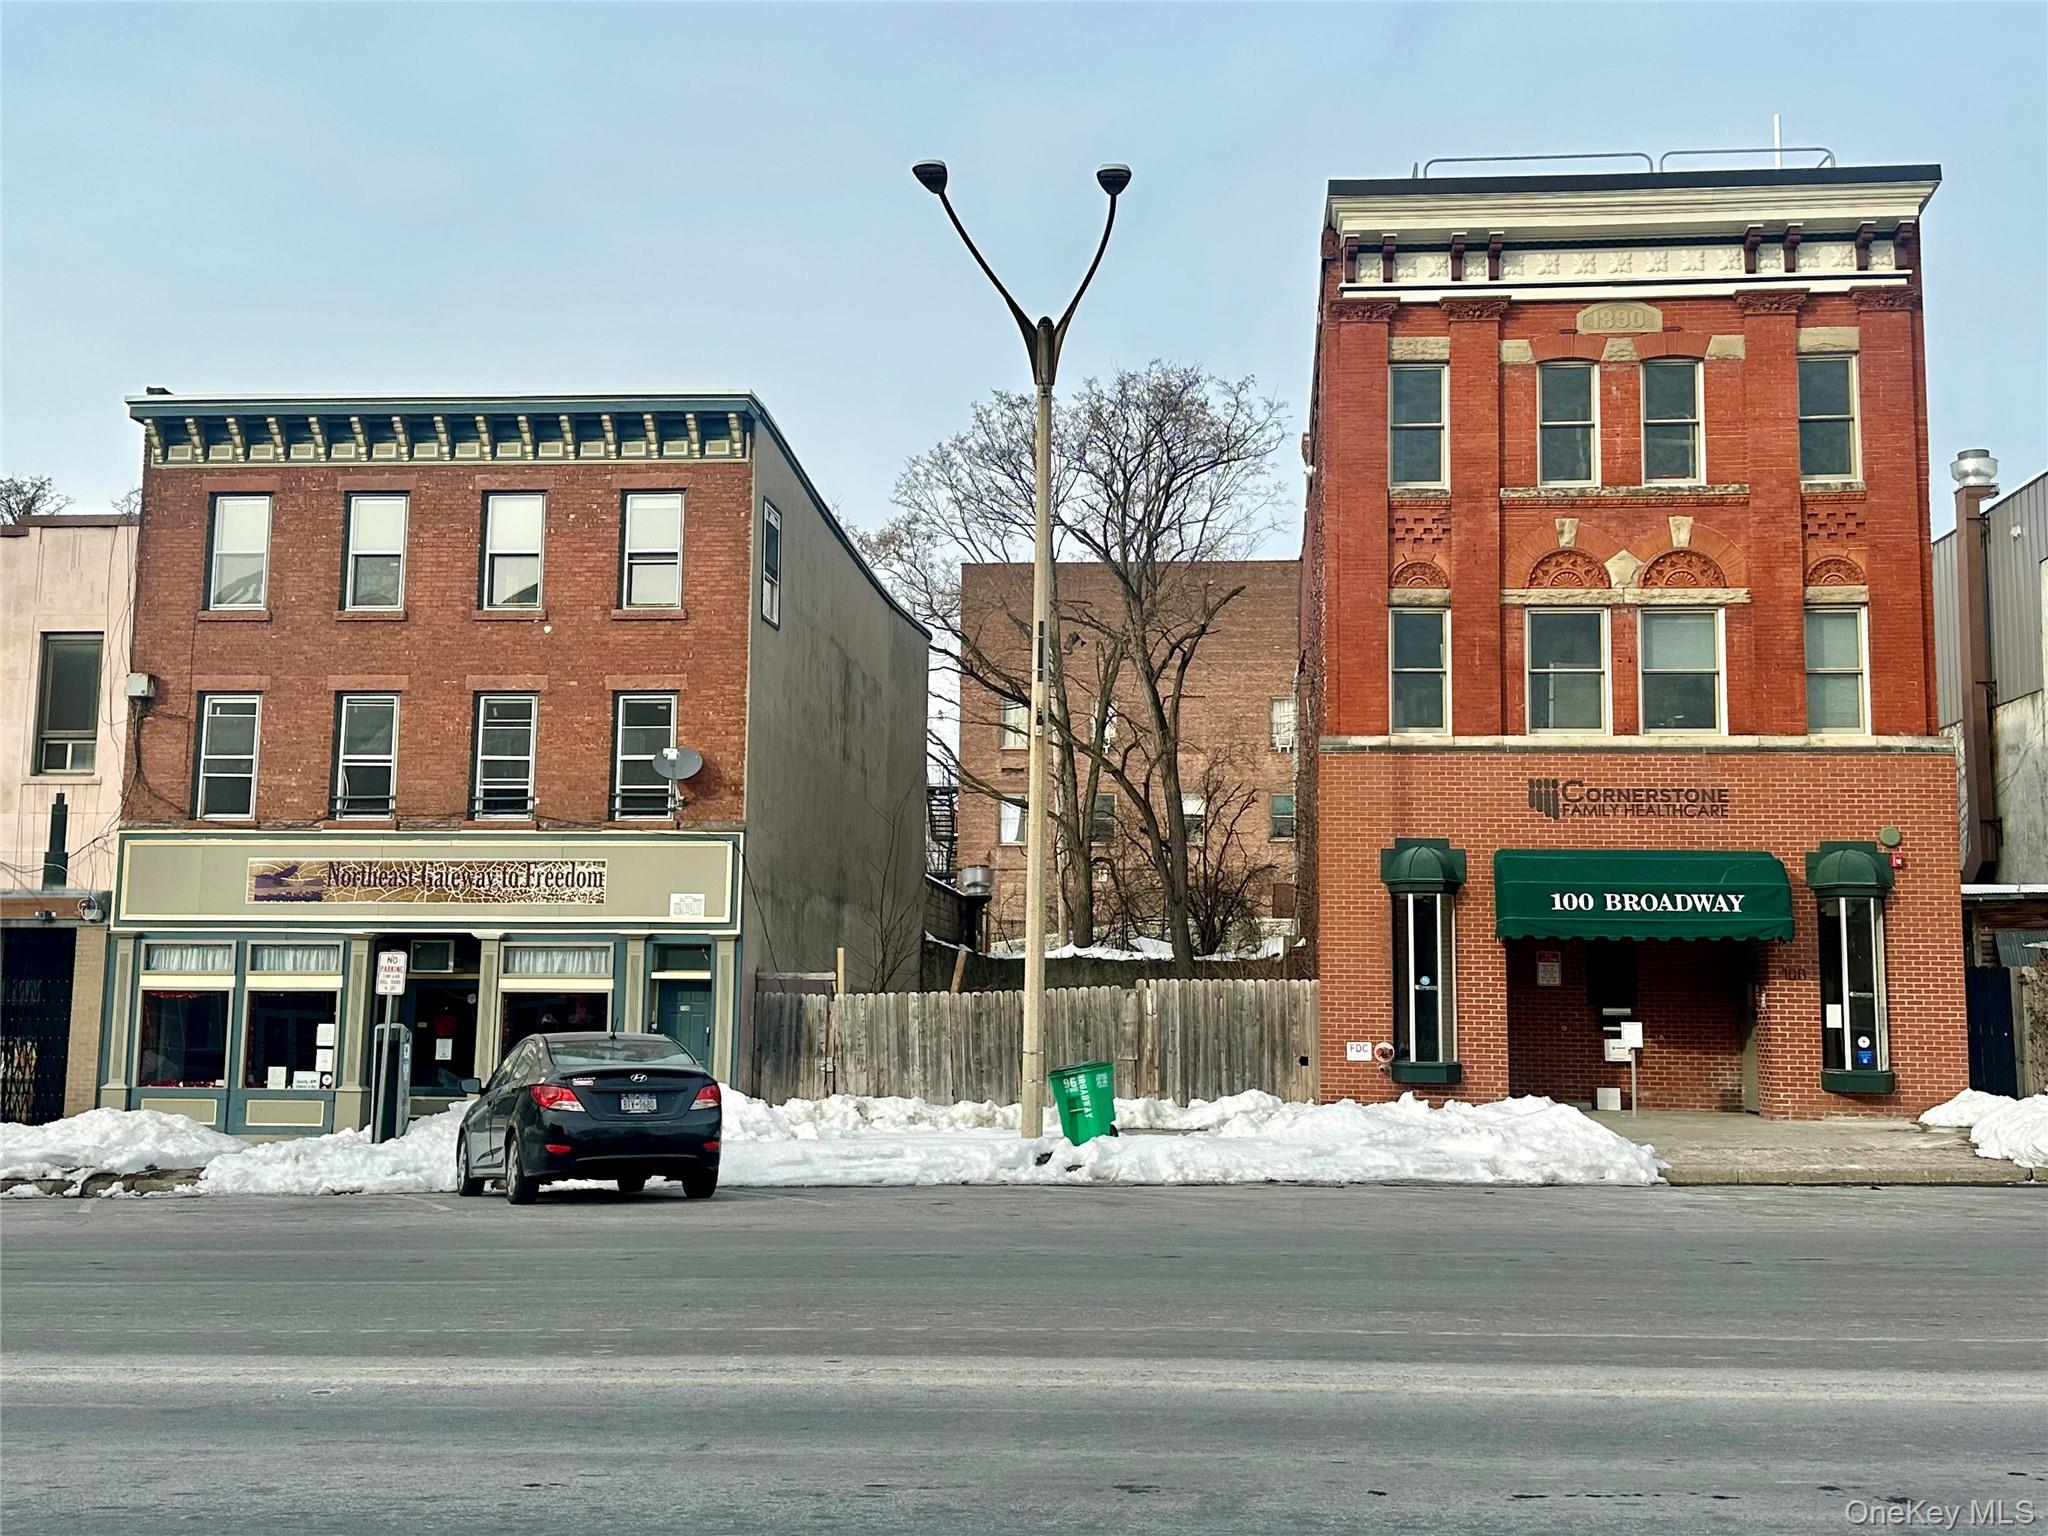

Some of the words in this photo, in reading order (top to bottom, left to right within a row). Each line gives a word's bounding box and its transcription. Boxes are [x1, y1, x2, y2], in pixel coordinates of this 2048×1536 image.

[1592, 310, 1645, 329] 1890
[1562, 780, 1729, 803] CORNERSTONE
[1562, 803, 1620, 817] FAMILY
[1624, 803, 1729, 817] HEALTHCARE
[328, 861, 413, 888] Northeast
[420, 861, 497, 892] Gateway
[501, 866, 519, 888] to
[524, 861, 603, 888] Freedom
[1550, 893, 1594, 911] 100
[1604, 893, 1745, 912] BROADWAY
[380, 965, 404, 973] PARKING
[387, 956, 398, 964] NO
[1350, 1044, 1369, 1053] FDC
[1077, 1073, 1094, 1118] BROADWAY
